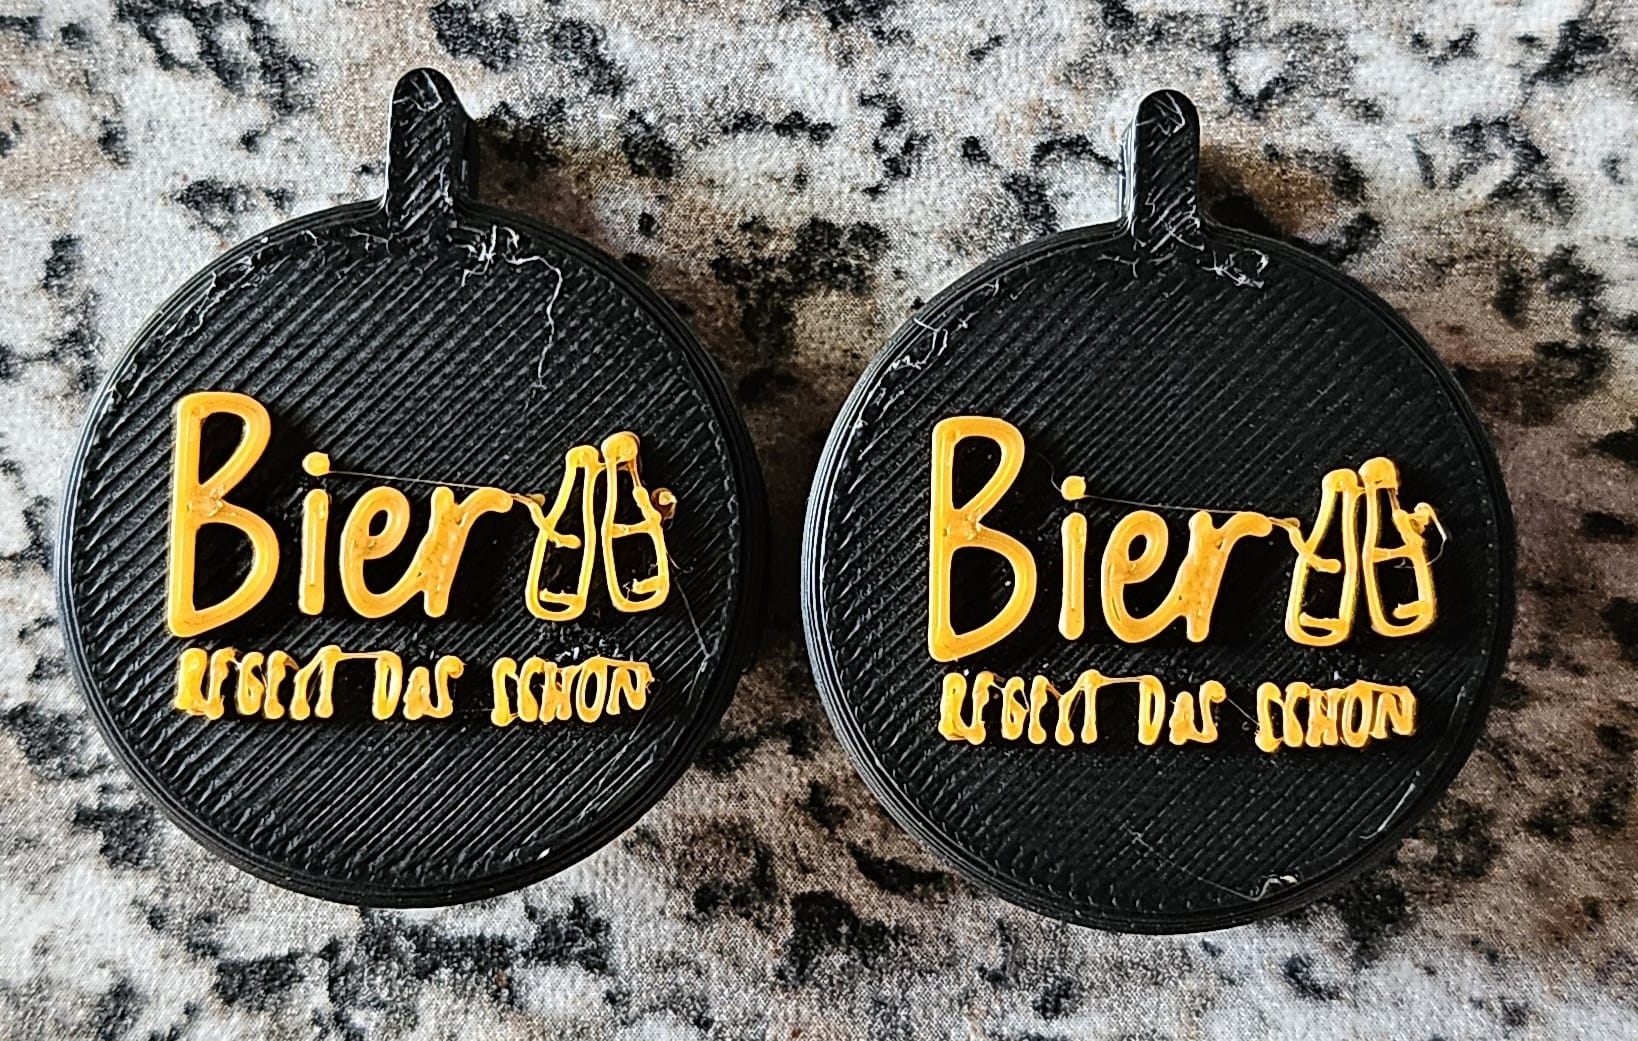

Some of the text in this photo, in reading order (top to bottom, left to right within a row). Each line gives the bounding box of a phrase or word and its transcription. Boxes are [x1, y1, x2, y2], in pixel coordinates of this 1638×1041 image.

[167, 390, 514, 639] Bier
[927, 414, 1275, 664] Bier
[372, 649, 465, 721] DAS
[1136, 674, 1228, 747] DAS
